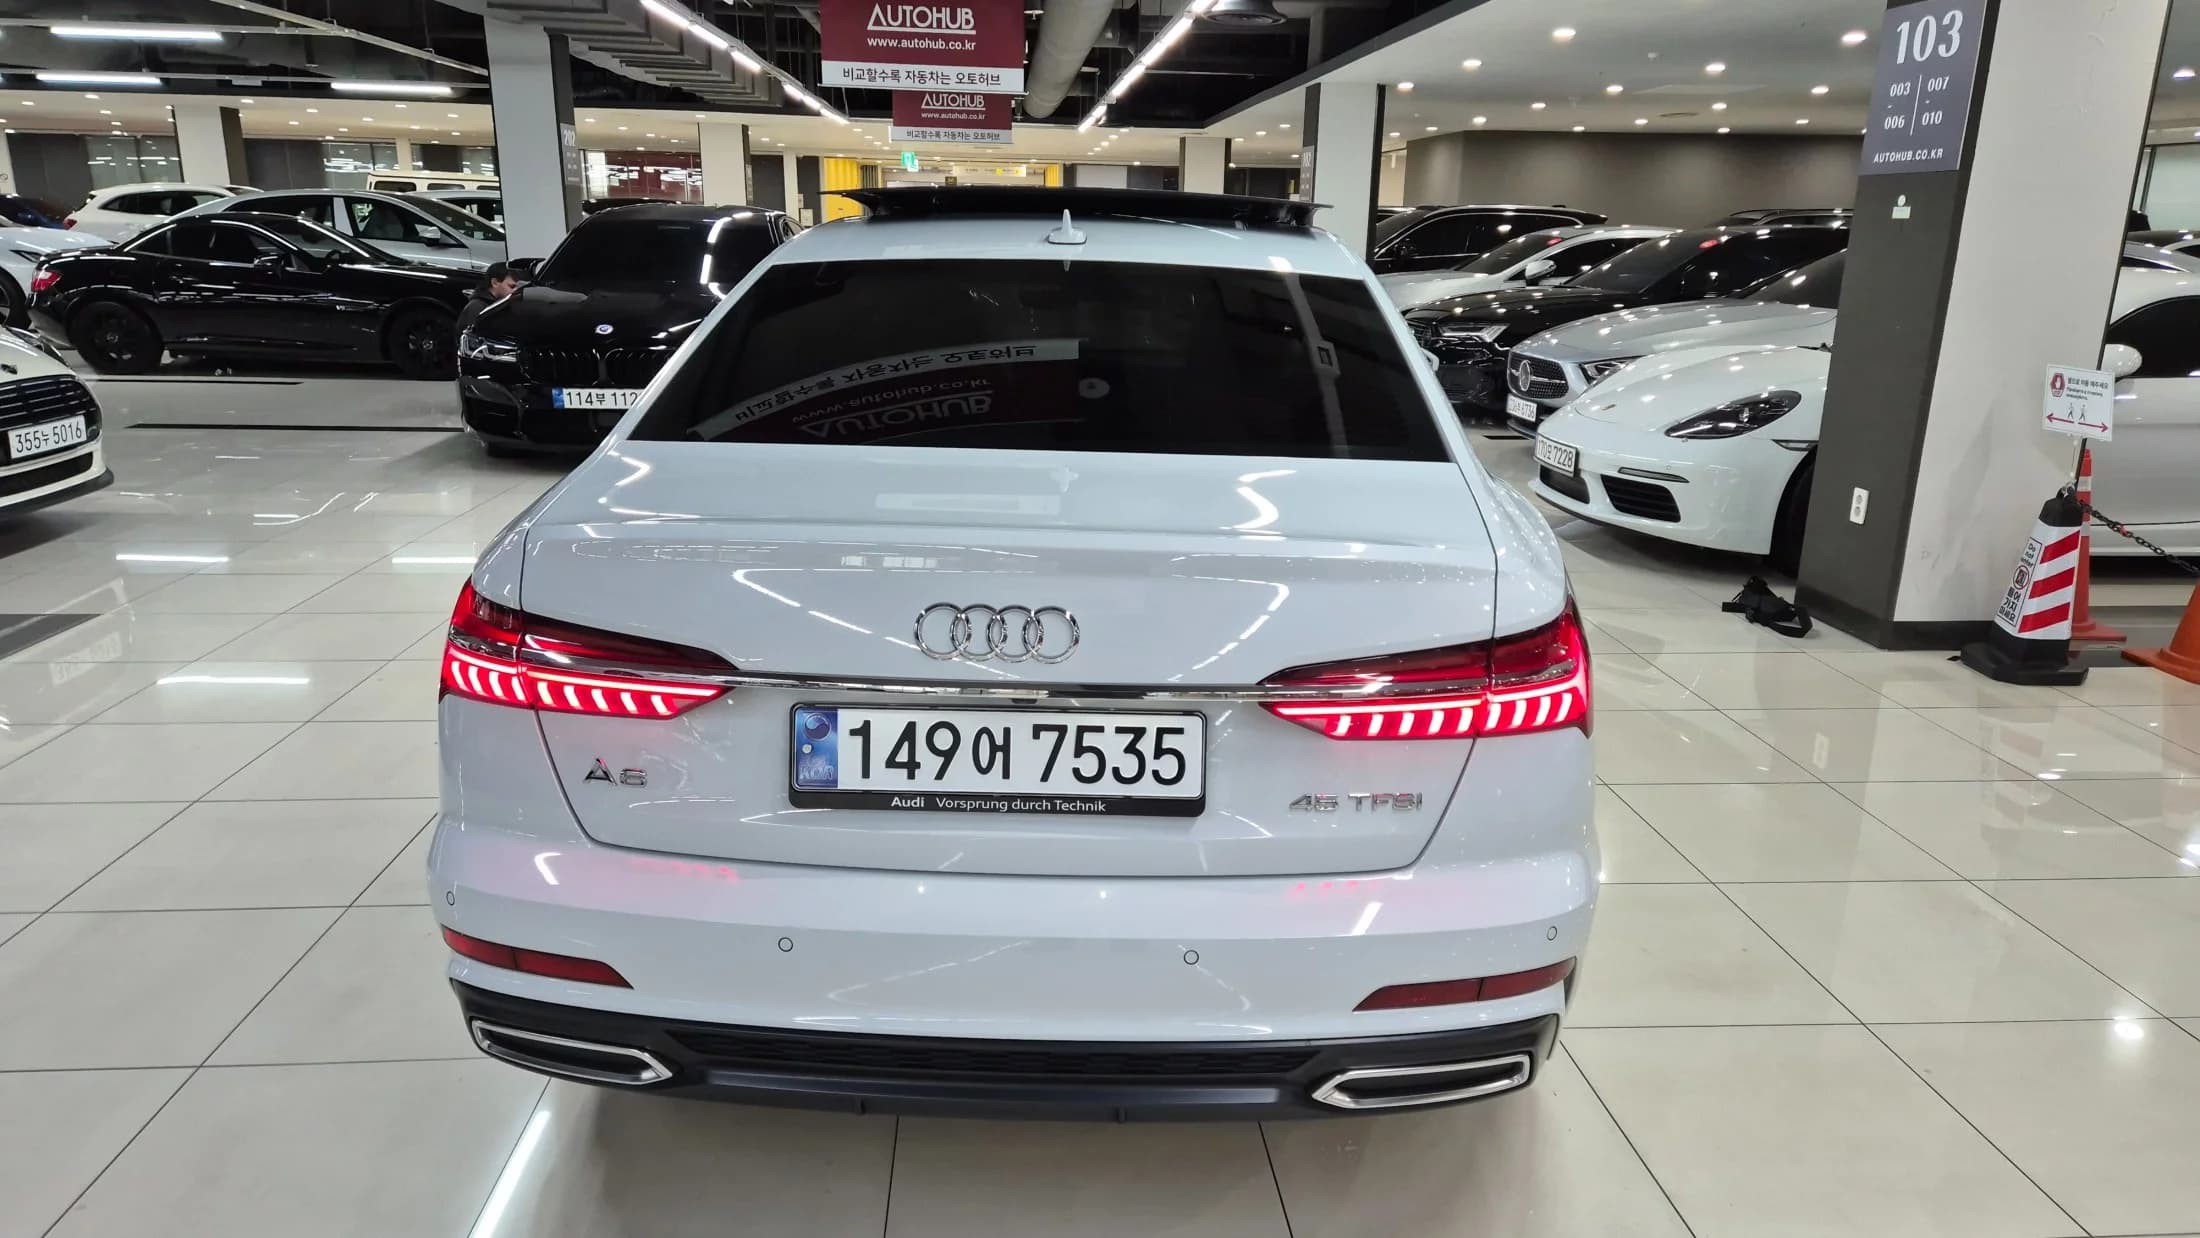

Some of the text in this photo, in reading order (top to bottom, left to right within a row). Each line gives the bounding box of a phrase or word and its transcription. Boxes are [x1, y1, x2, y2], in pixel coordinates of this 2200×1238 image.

[867, 3, 976, 34] AUTOHUB
[867, 37, 976, 51] www.autohub.co.kr
[1896, 9, 1964, 65] 103
[843, 67, 1001, 87] 비교할수록 자동차는 오토허브
[1927, 76, 1950, 92] 007
[1889, 82, 1911, 97] 003
[921, 93, 986, 110] AUTOHUB
[921, 111, 985, 120] www.autohub.co.kr
[1884, 115, 1905, 130] 006
[1921, 111, 1943, 126] 010
[906, 130, 1001, 141] 비교할수록 자동차는 오토허브
[1873, 148, 1943, 164] AUTOHUB.CO.KR
[567, 391, 642, 406] 114부 112
[15, 421, 82, 454] 355누 5016
[1553, 446, 1574, 469] 7228
[849, 719, 1186, 787] 149어 7535
[582, 757, 648, 788] A6
[891, 796, 1107, 812] Audi Vorsprung durch Technik
[1289, 792, 1423, 812] 45 TFSI
